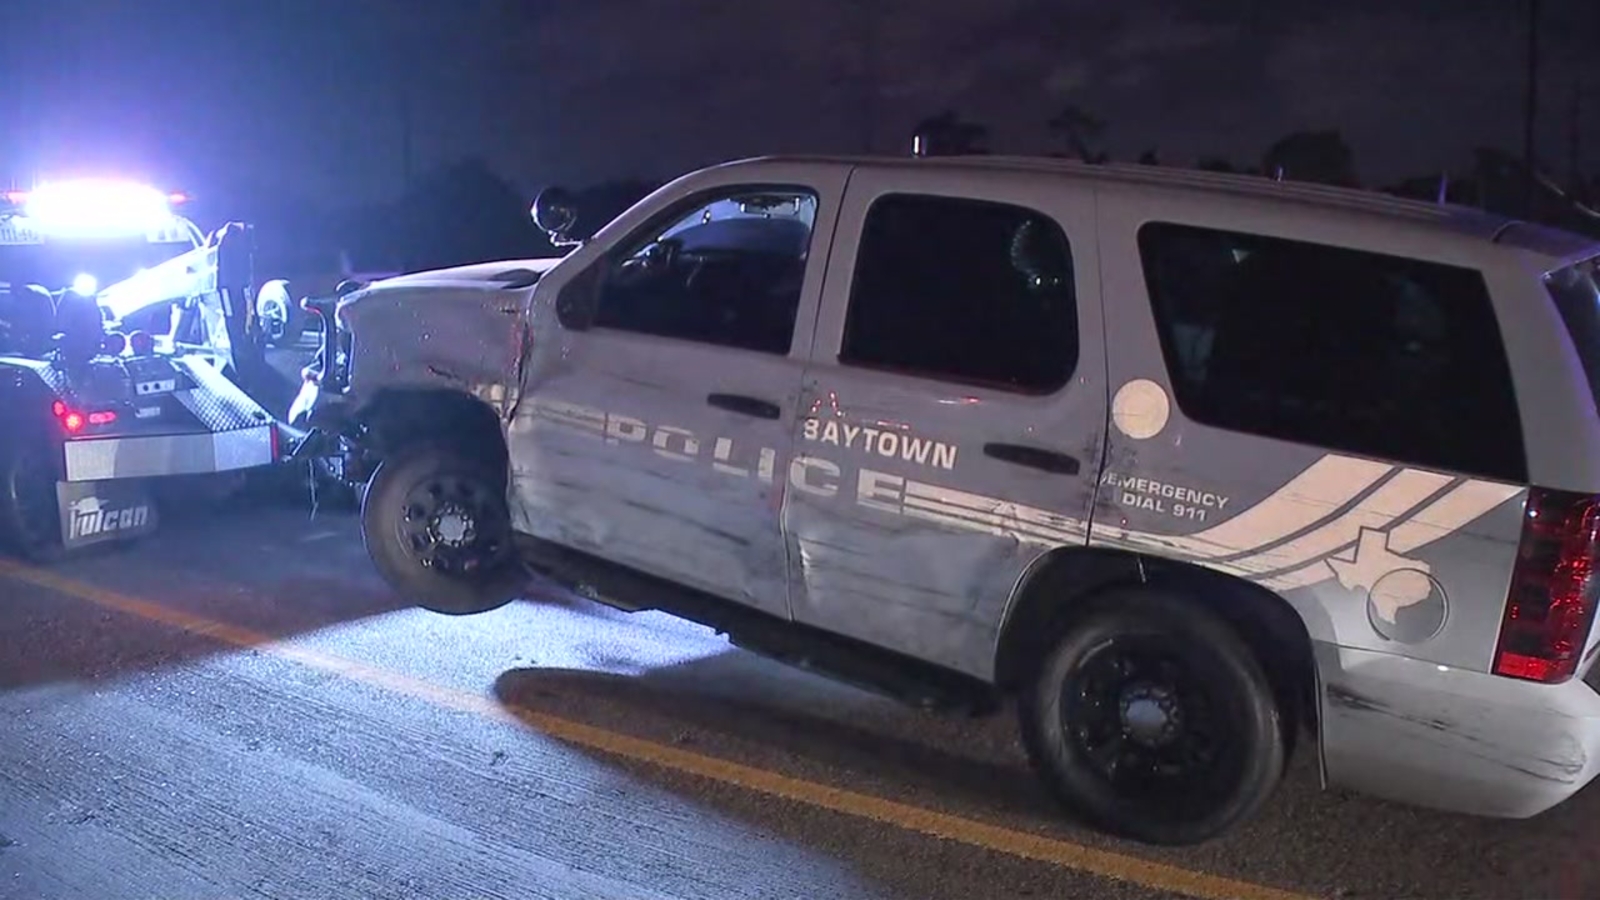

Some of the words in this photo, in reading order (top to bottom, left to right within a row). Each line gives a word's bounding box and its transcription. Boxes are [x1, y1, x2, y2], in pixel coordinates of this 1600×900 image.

[604, 414, 905, 515] POLICE
[803, 418, 957, 470] BAYTOWN
[1106, 472, 1229, 509] EMERGENCY
[1122, 492, 1165, 513] DIAL
[1173, 503, 1207, 521] 911
